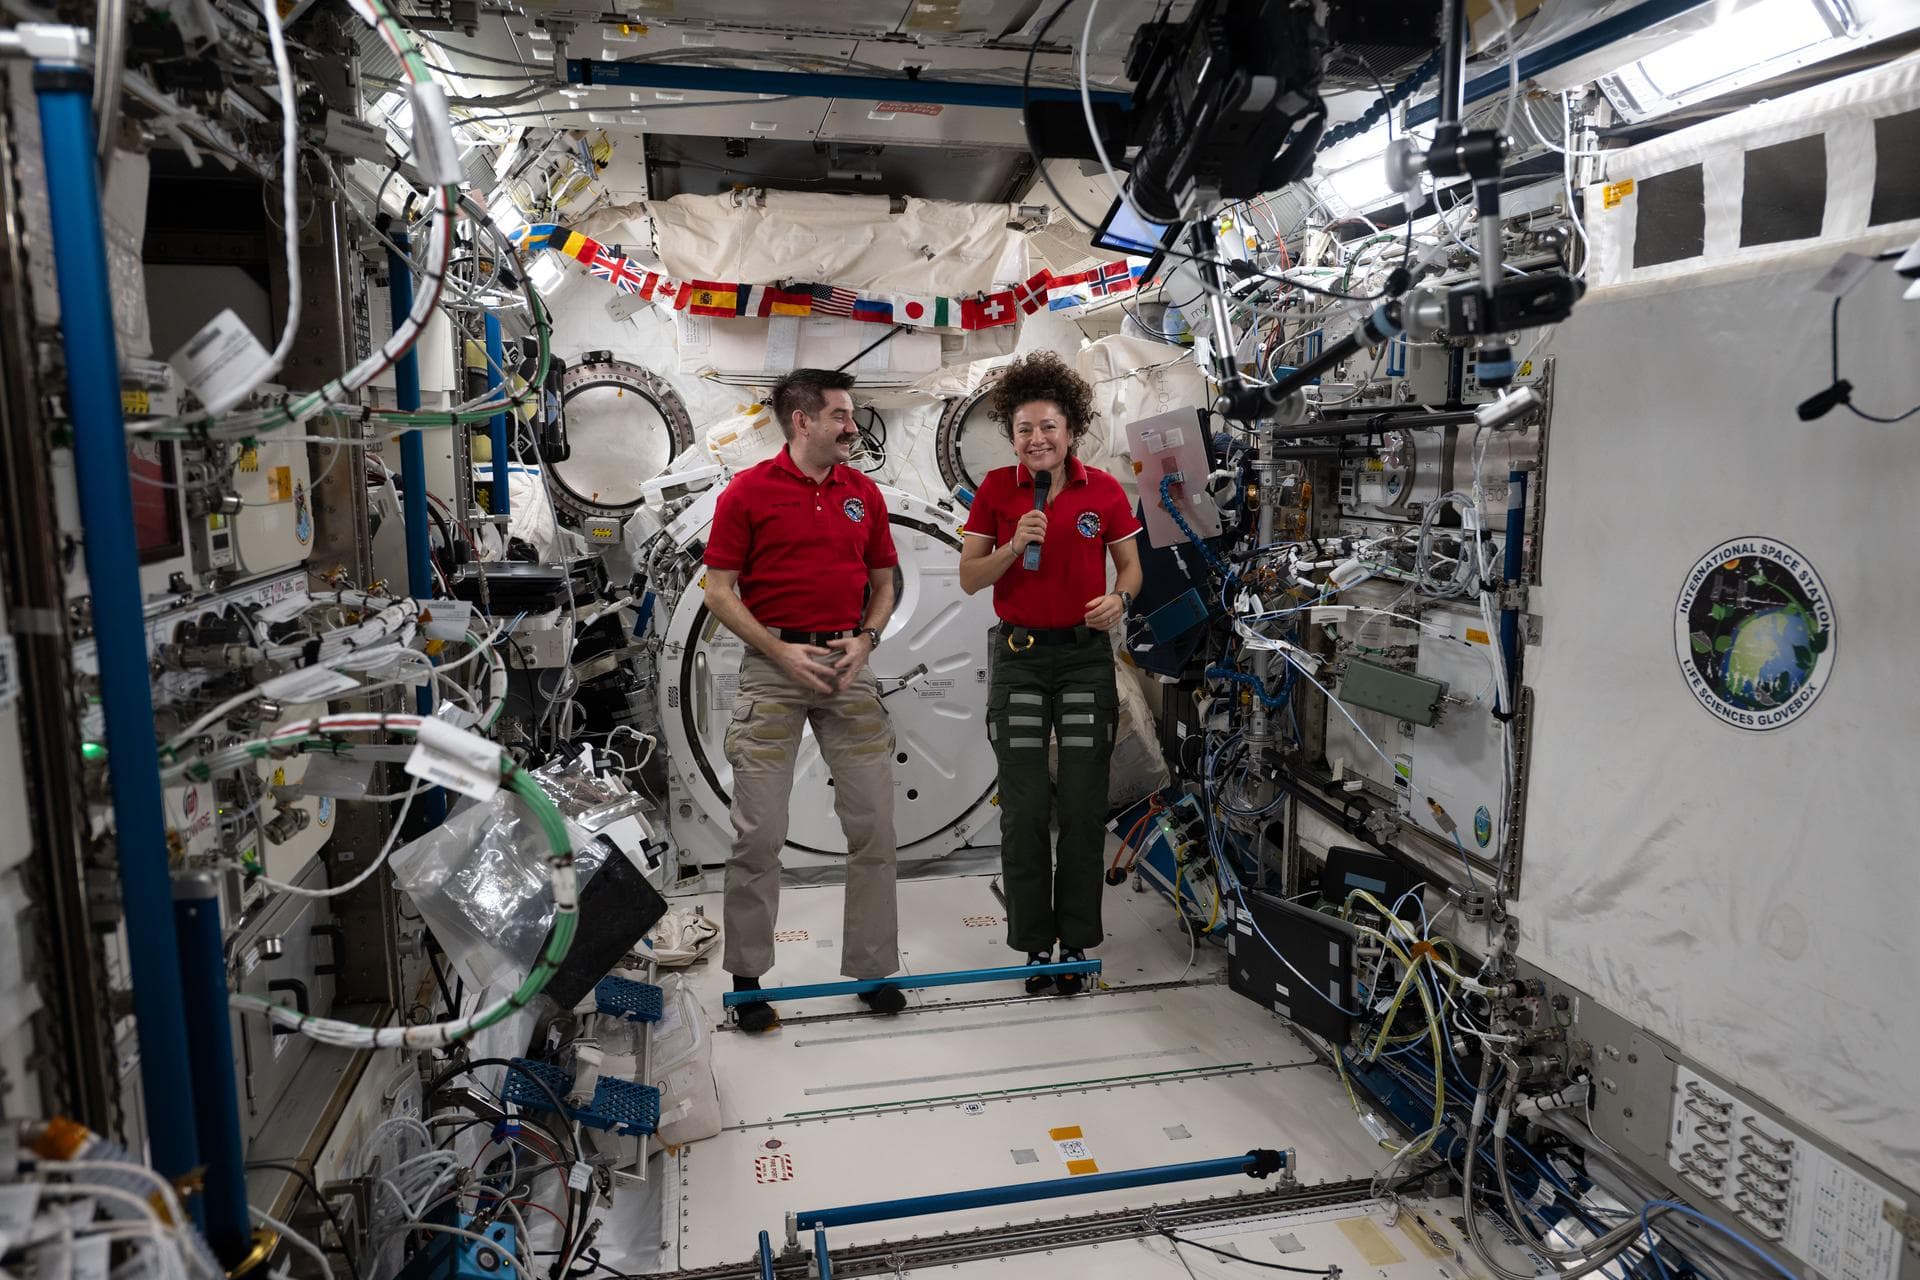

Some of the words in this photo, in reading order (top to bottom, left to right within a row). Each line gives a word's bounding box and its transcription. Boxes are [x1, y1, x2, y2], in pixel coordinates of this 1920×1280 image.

[1679, 543, 1757, 614] INTERNATIONAL
[1760, 544, 1802, 572] SPACE
[1798, 569, 1830, 632] STATION
[1683, 658, 1704, 689] LIFE
[1698, 684, 1755, 726] SCIENCES
[1757, 681, 1819, 726] GLOVEBOX
